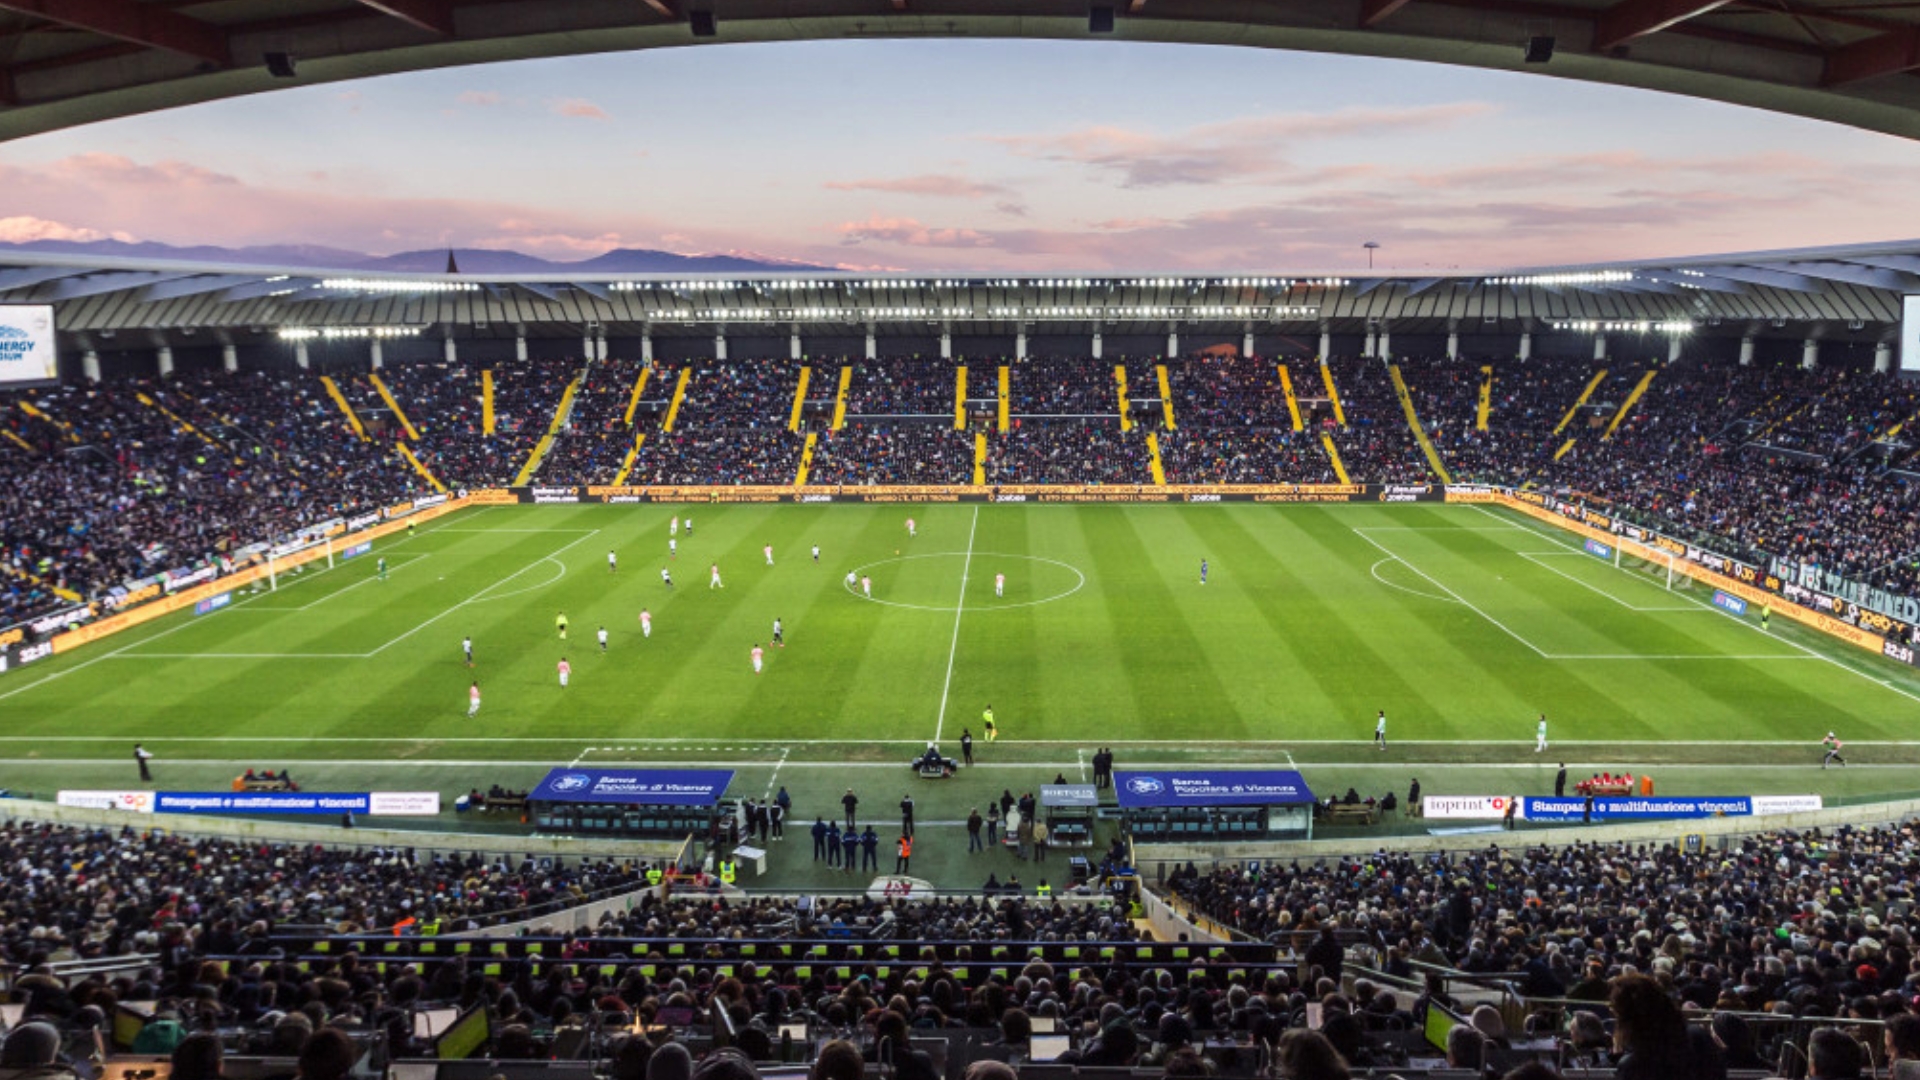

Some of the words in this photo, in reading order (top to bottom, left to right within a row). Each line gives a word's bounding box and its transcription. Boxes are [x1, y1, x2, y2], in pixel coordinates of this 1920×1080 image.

[1725, 598, 1742, 611] TIM
[600, 776, 637, 784] Banca
[594, 784, 648, 792] Popolare
[651, 783, 662, 791] di
[666, 784, 713, 792] Vicenza
[1174, 785, 1229, 793] Popolare
[1231, 784, 1244, 793] di
[318, 797, 367, 808] vincenti
[1532, 800, 1596, 814] Stampani
[1598, 802, 1606, 812] e
[1609, 800, 1696, 813] multifunzione
[1699, 800, 1748, 813] vincenti
